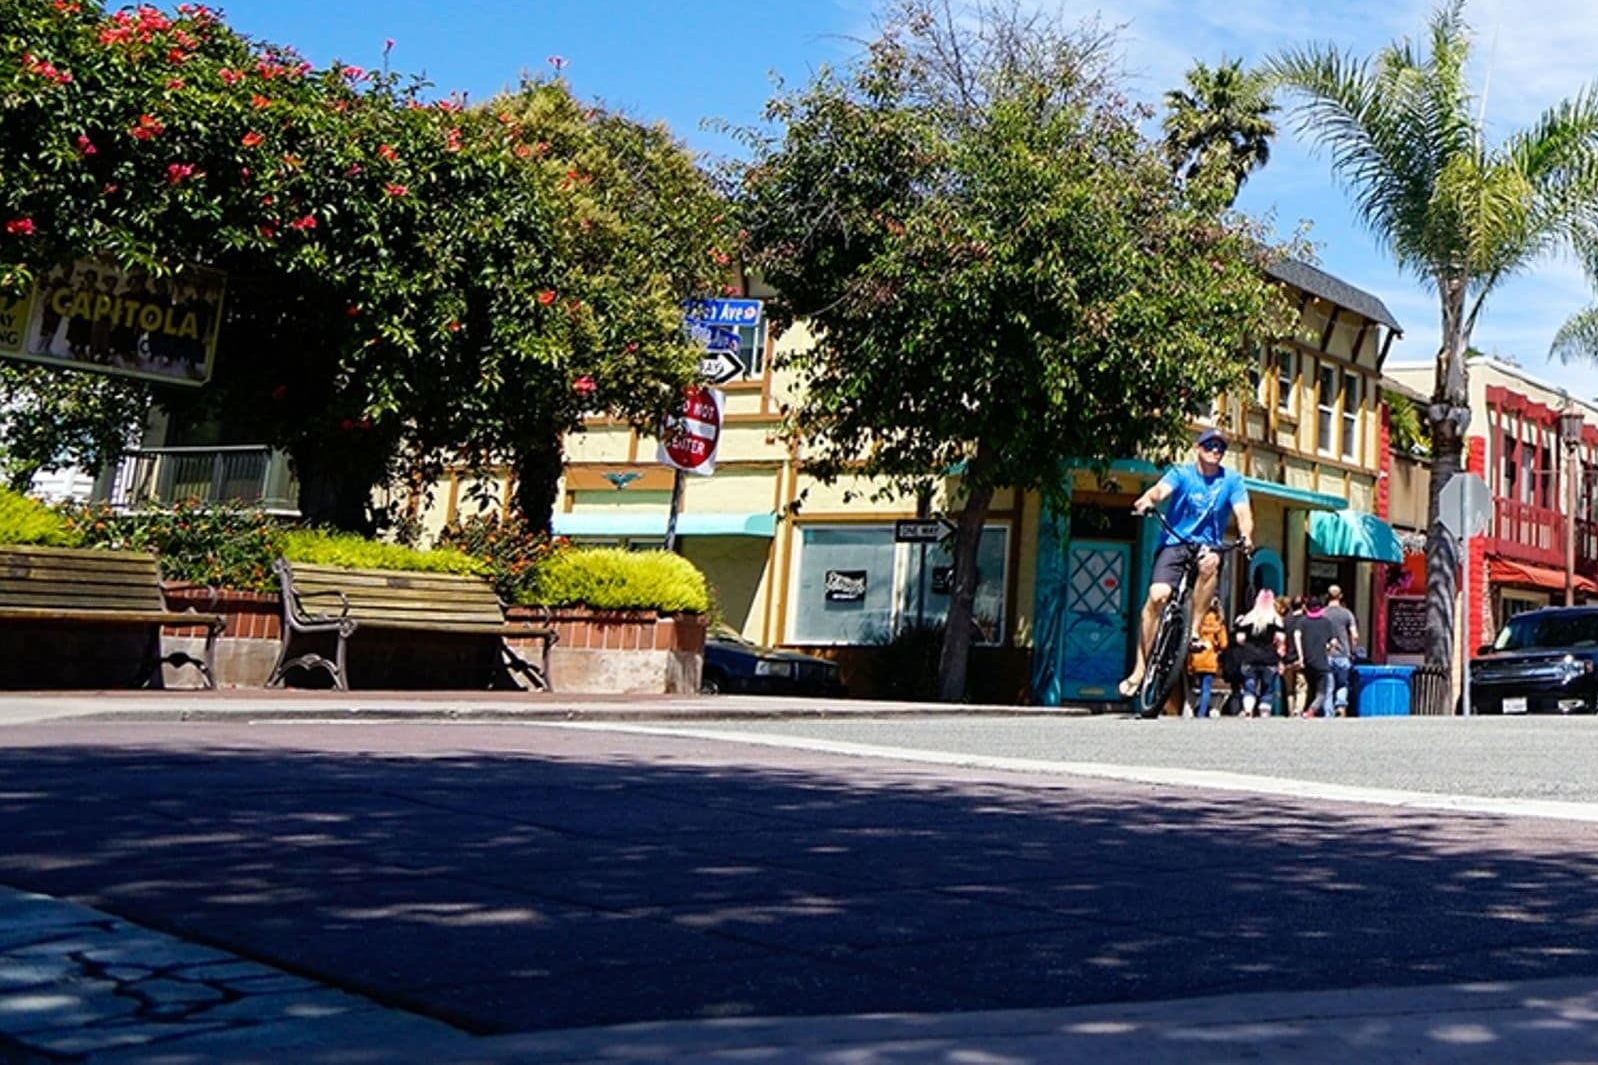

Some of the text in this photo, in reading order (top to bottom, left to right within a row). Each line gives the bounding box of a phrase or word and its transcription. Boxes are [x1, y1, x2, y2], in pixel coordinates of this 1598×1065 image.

[52, 287, 198, 340] CAPITOLA
[719, 302, 743, 321] Ave
[693, 403, 715, 420] NOT
[671, 437, 706, 455] ENTER
